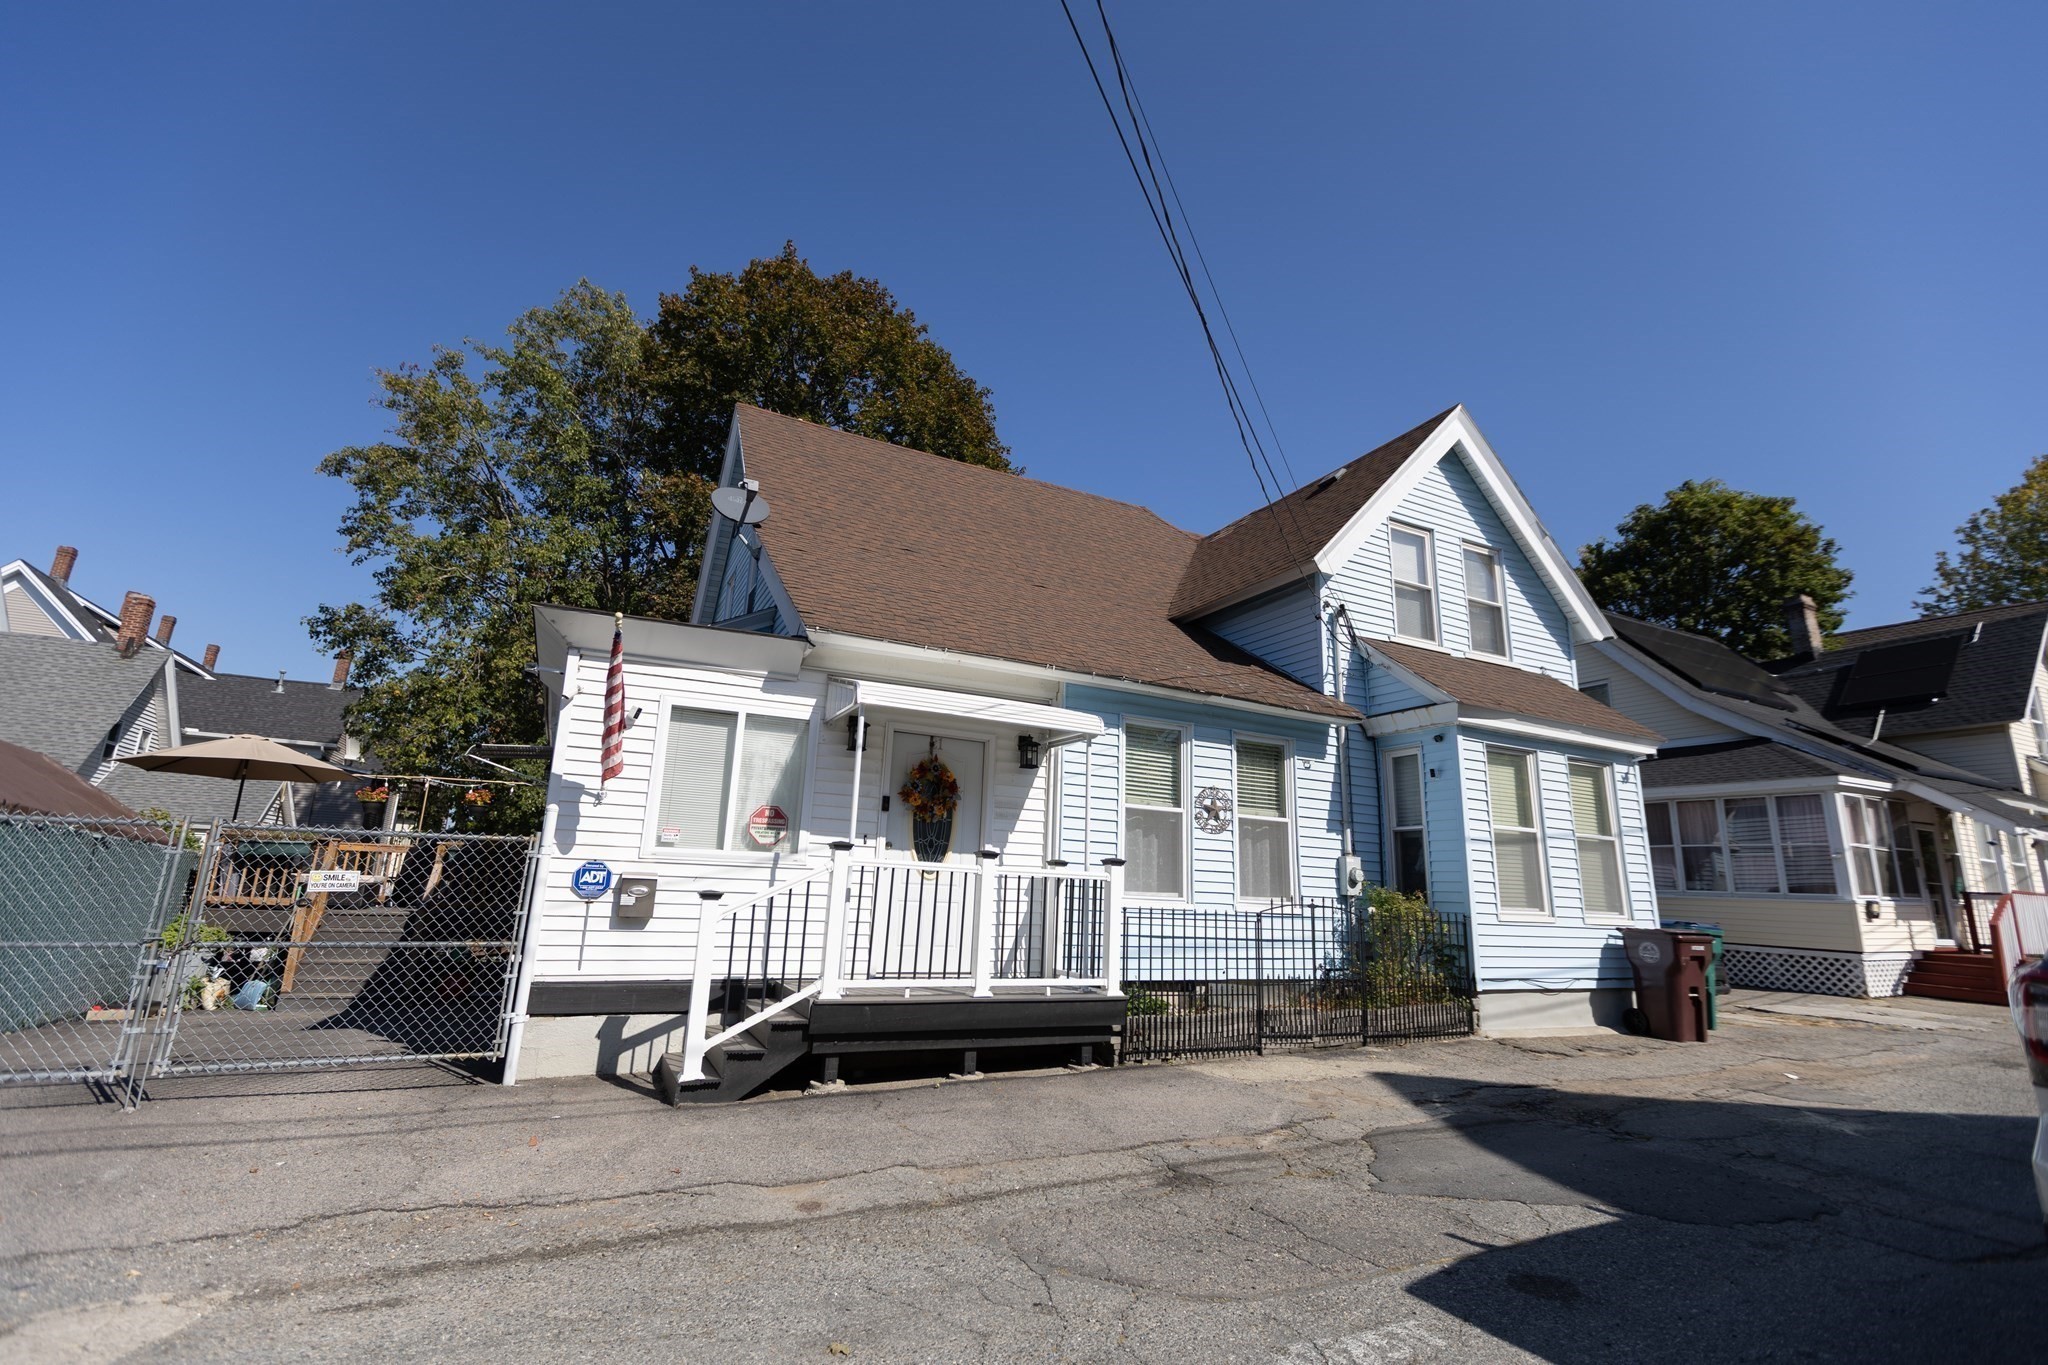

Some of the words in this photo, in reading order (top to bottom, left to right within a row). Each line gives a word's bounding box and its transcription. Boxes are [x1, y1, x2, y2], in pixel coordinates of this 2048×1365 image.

[764, 809, 775, 818] NO
[752, 817, 786, 825] TRESPASSING
[323, 873, 346, 882] SMILE
[580, 870, 607, 884] ADT
